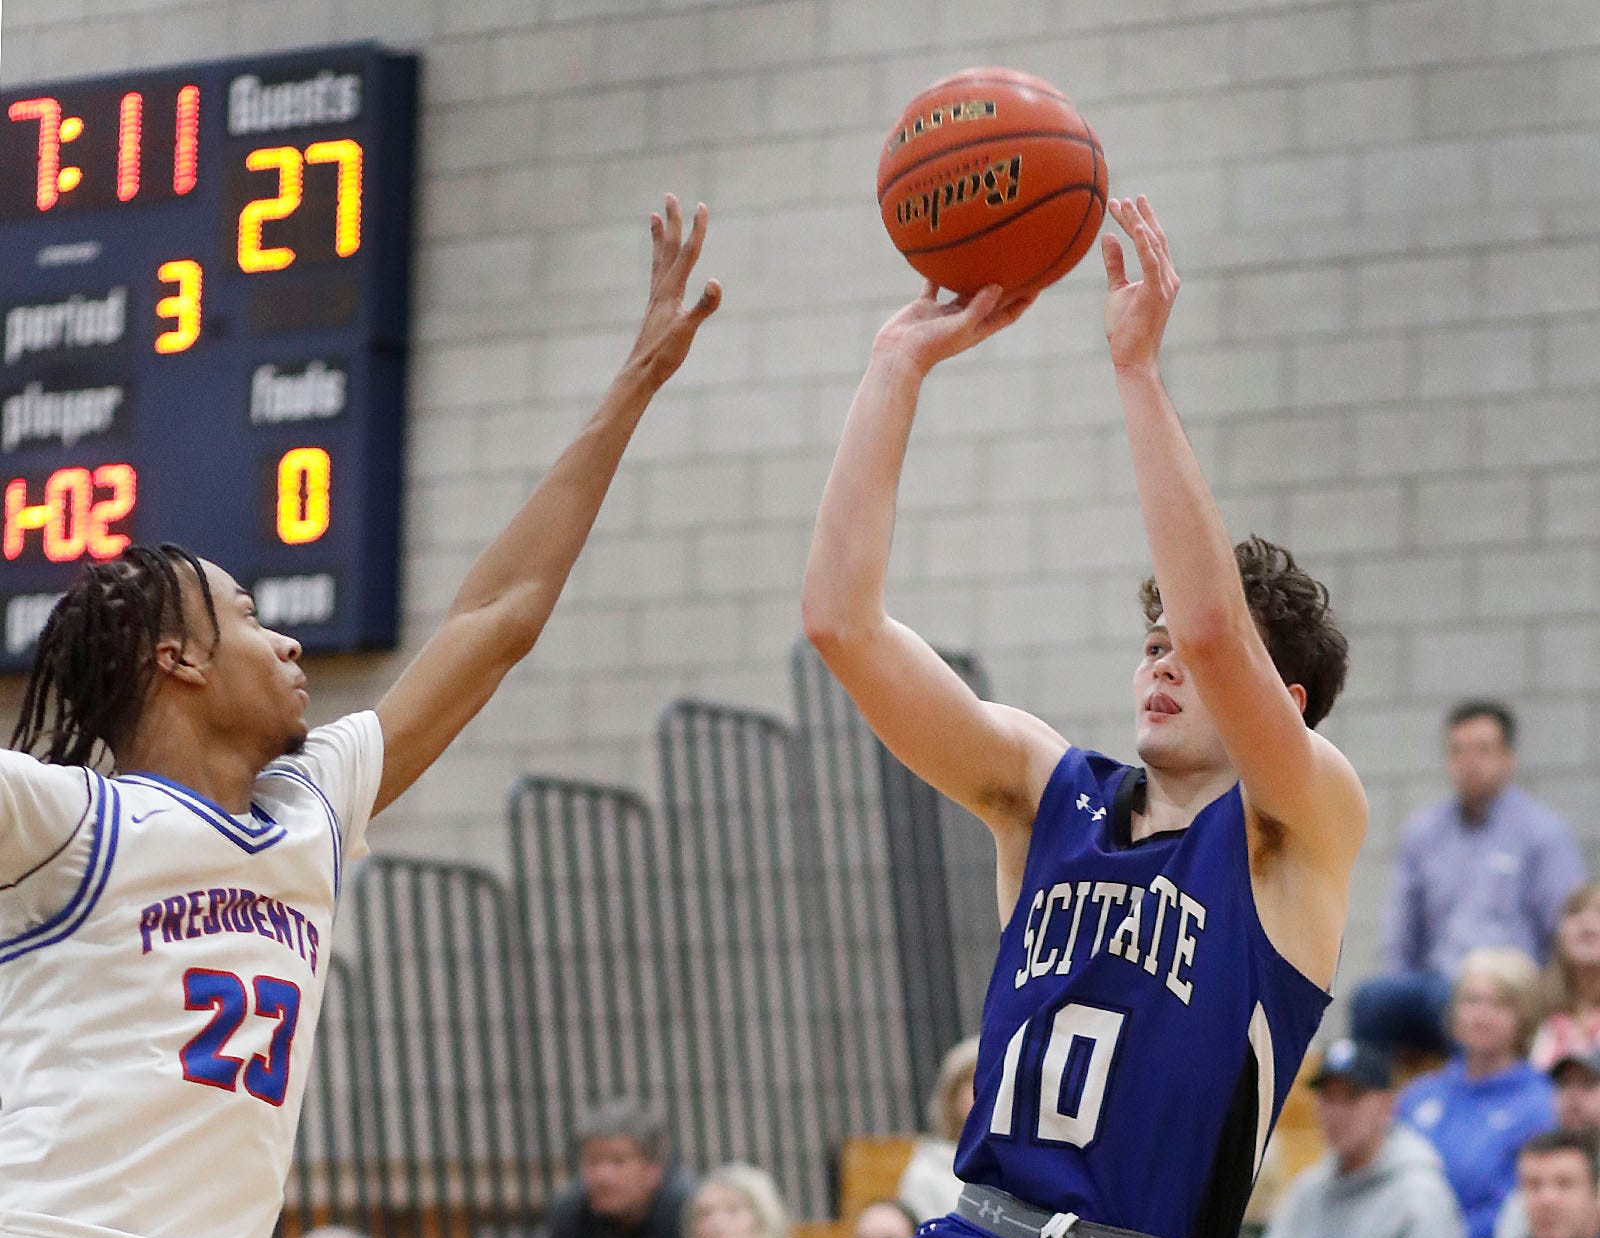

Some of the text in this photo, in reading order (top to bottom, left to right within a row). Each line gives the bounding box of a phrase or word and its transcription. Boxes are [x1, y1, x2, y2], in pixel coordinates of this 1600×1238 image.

[7, 84, 200, 212] 7:11
[228, 72, 363, 136] Guests
[237, 138, 363, 273] 27
[896, 153, 1022, 232] Baden
[155, 259, 203, 354] 3
[277, 446, 331, 545] 0
[140, 887, 320, 976] PRESIDENTS
[179, 967, 302, 1107] 23
[989, 1003, 1126, 1149] 10
